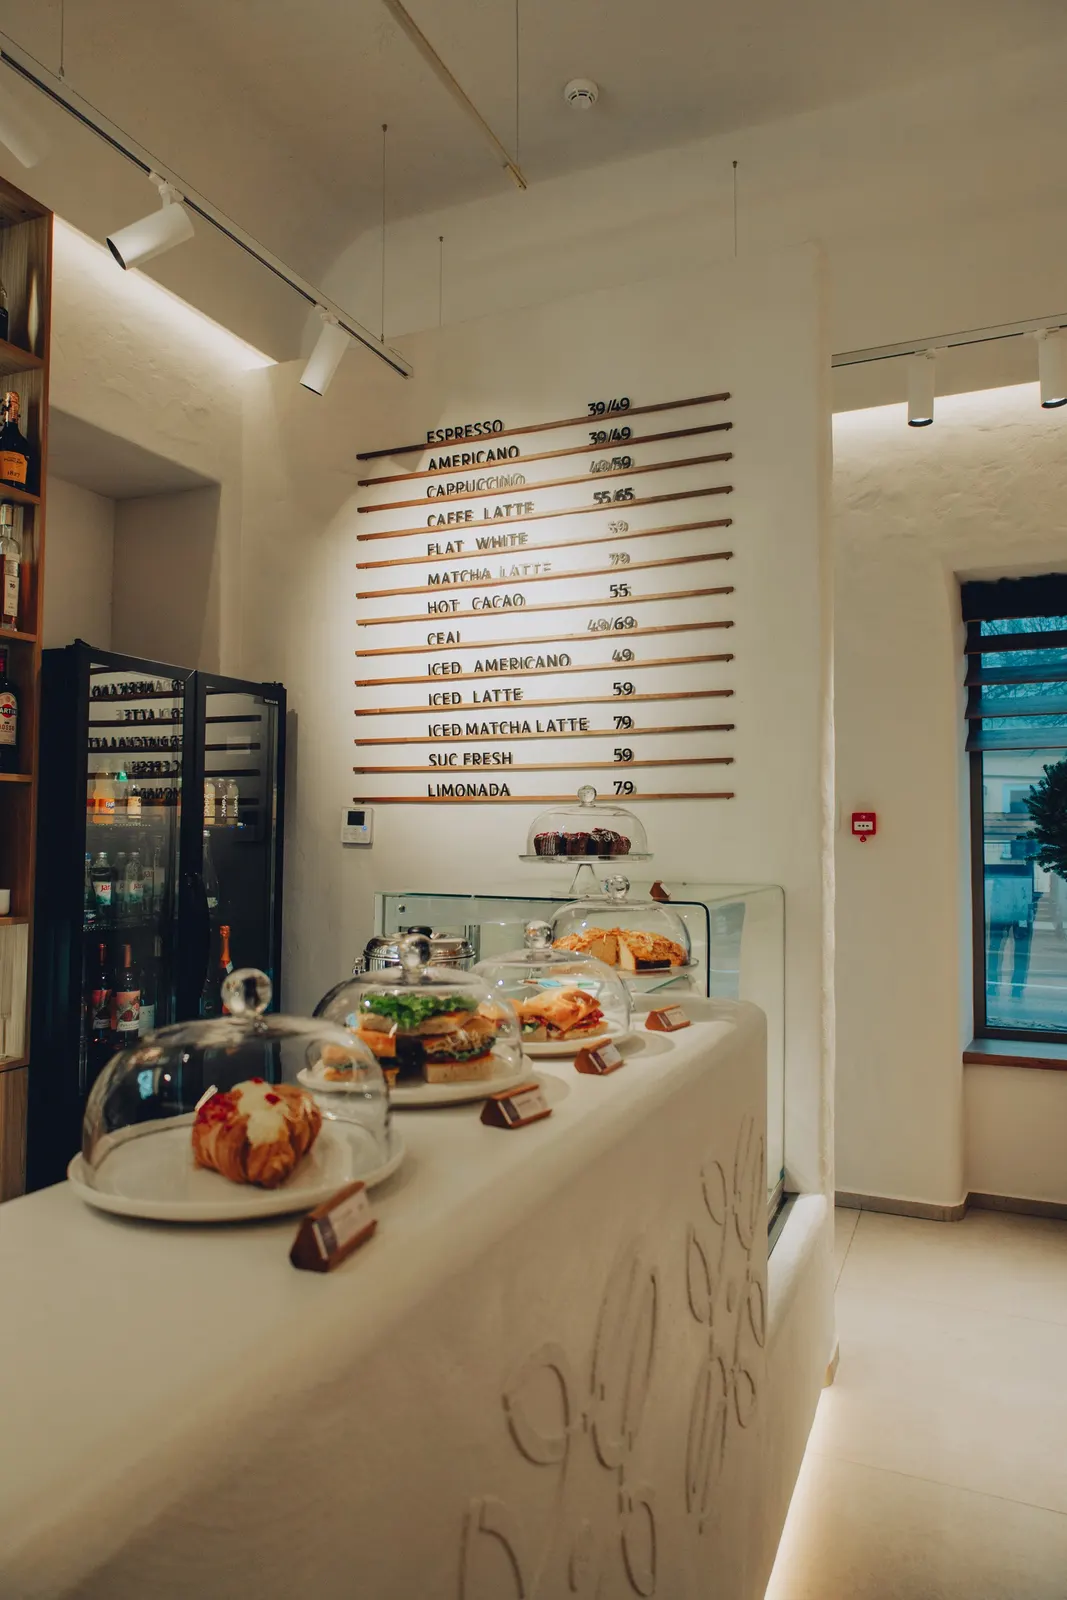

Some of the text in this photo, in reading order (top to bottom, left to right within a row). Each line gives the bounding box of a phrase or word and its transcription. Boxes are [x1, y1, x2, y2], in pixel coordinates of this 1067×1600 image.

[427, 397, 630, 443] ESPRESSO 39/49
[428, 427, 631, 470] AMERICANO 39/49
[427, 473, 525, 498] CAPPUCCINO
[427, 487, 634, 526] CAFFE LATTE 55/65
[427, 540, 464, 555] FLAT
[476, 532, 528, 550] WHITE
[427, 568, 491, 585] MATCHA
[500, 562, 551, 578] LATTE
[427, 583, 630, 614] HOT CACAO 55
[427, 631, 460, 645] CEAI
[428, 649, 633, 676] ICED AMERICANO 49
[428, 682, 635, 706] ICED LATTE 59
[428, 716, 634, 737] ICED MATCHA LATTE 79
[428, 748, 634, 766] SUC FRESH 59
[428, 781, 635, 797] LIMONADA 79
